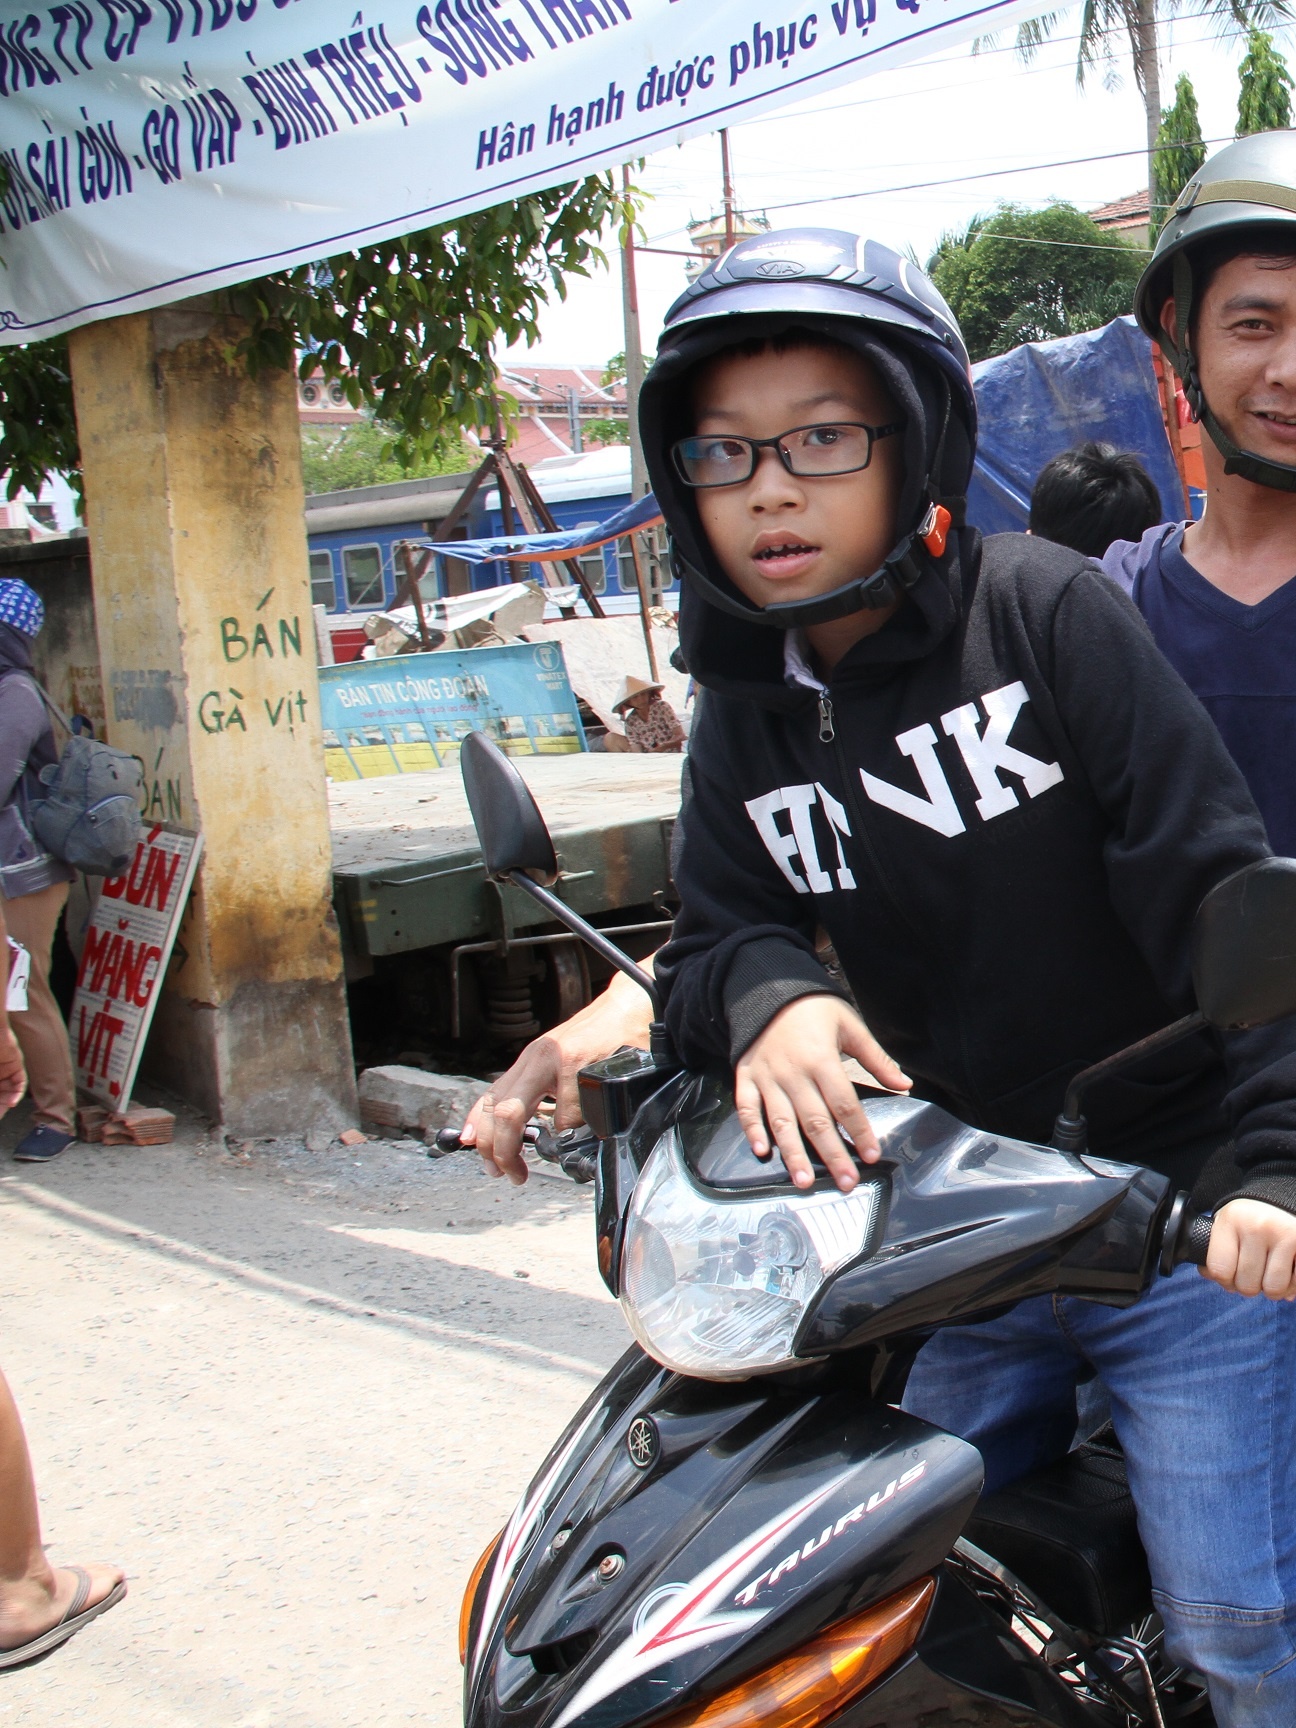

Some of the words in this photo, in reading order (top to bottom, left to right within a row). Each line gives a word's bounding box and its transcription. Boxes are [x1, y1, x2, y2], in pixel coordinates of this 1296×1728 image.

[47, 0, 94, 76] TY
[26, 119, 71, 211] SÀI
[75, 106, 133, 205] GÒN
[143, 85, 182, 185] GÒ
[181, 60, 243, 173] VẤP
[242, 50, 339, 151] BÌNH
[303, 10, 422, 127] TRIỆU
[476, 121, 536, 171] Hân
[546, 81, 626, 146] hạnh
[636, 54, 716, 113] được
[729, 13, 818, 88] phục
[830, 0, 877, 37] vụ
[220, 586, 302, 663] BÁN
[335, 679, 373, 709] BẢN
[367, 682, 398, 705] TIN
[395, 674, 442, 702] CÔNG
[440, 669, 491, 700] ĐOÀN
[76, 918, 162, 1009] MĂNG
[78, 998, 125, 1088] VỊT
[732, 1459, 928, 1607] TAURUS
